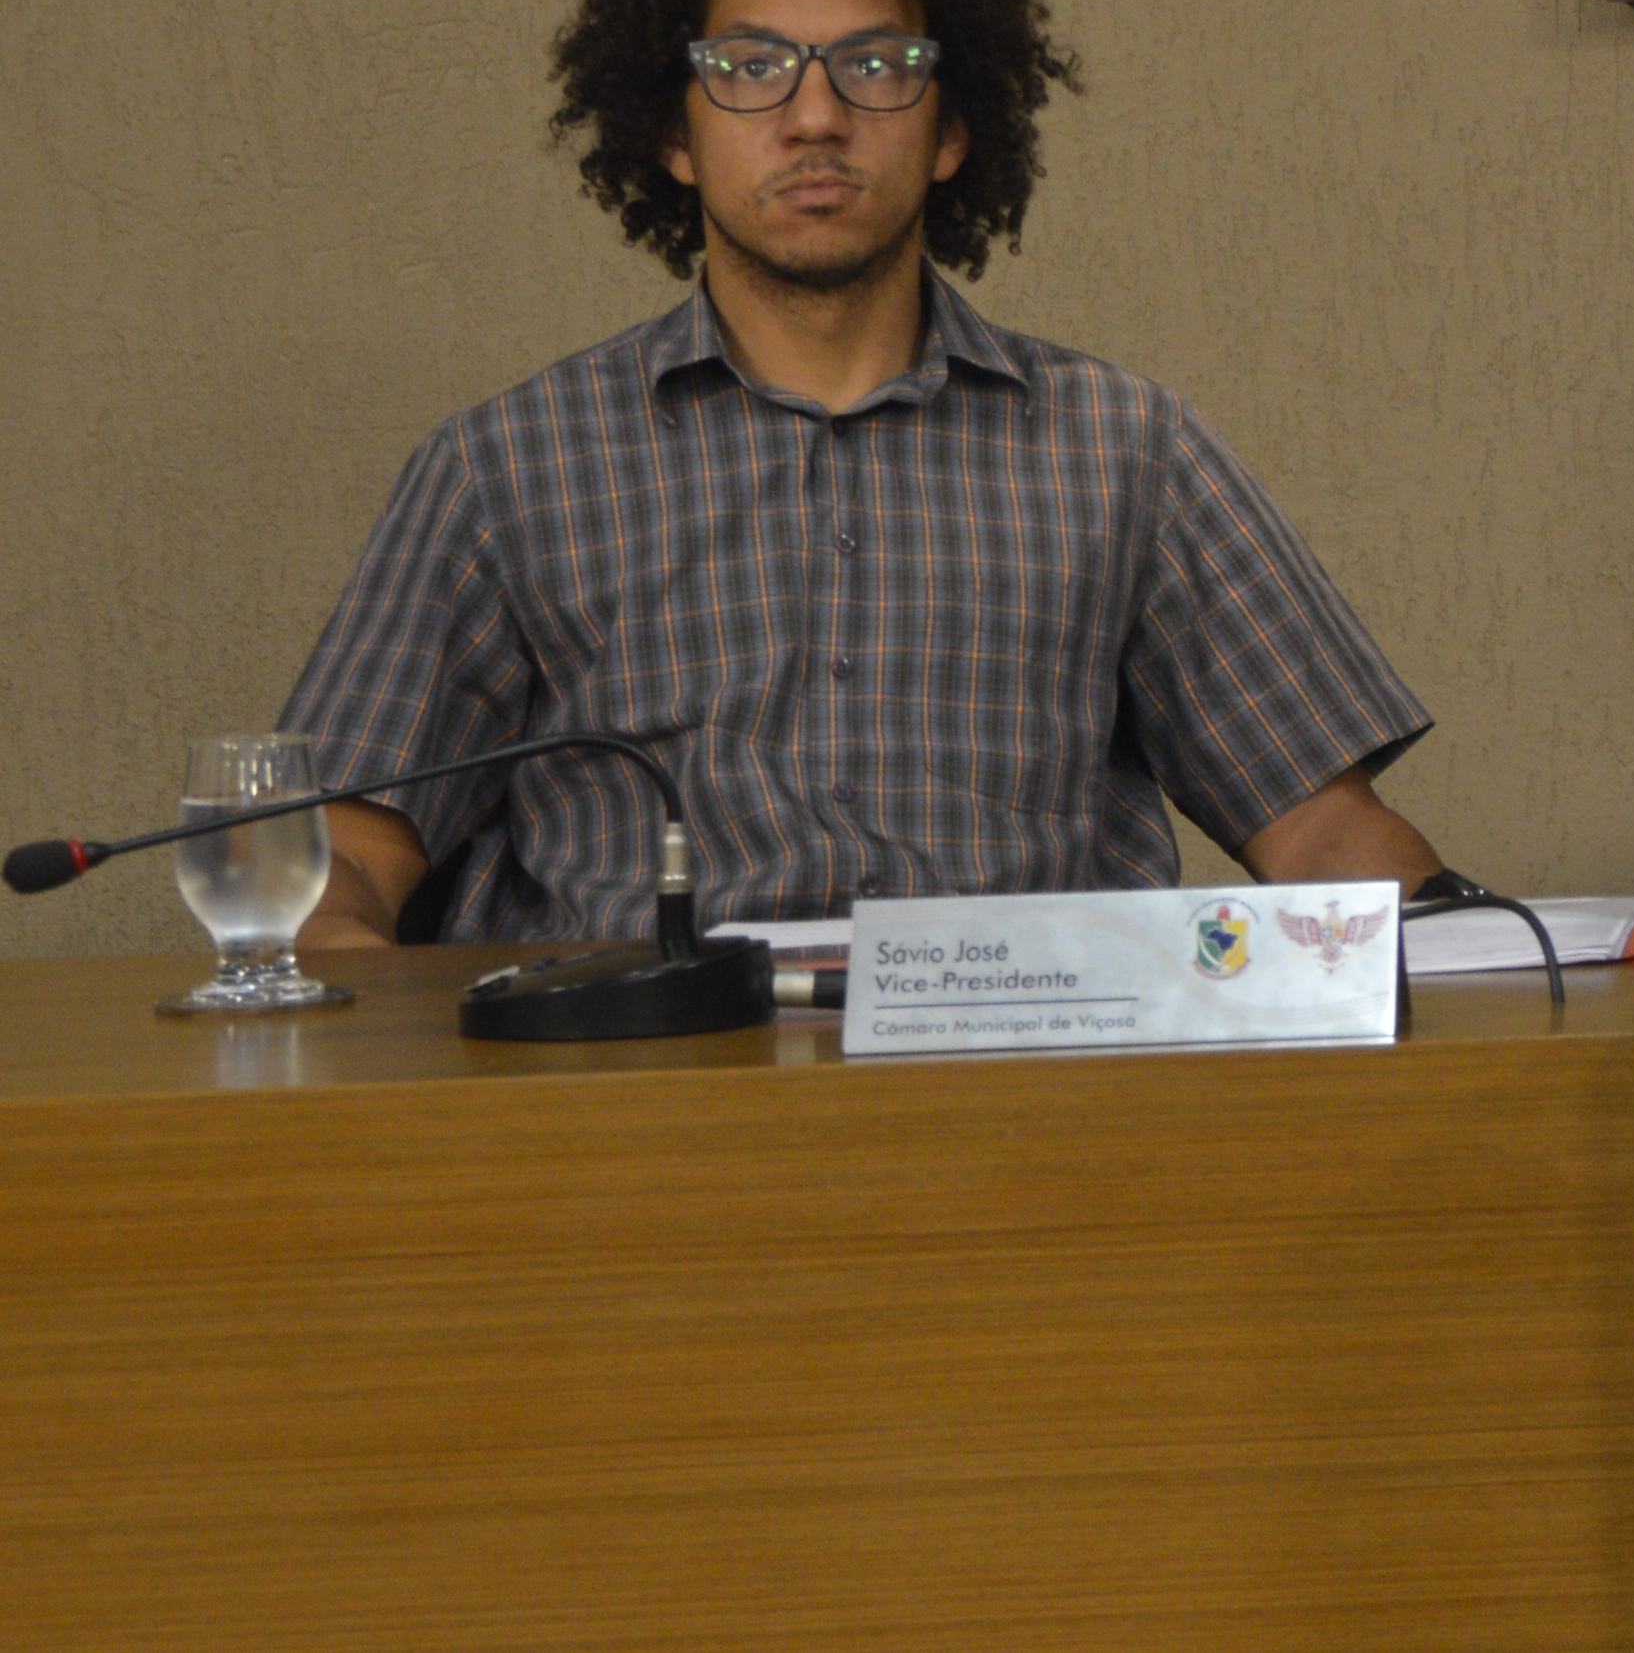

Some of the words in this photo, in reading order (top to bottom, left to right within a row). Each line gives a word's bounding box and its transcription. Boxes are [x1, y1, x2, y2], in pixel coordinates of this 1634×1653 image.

[877, 940, 944, 965] Sávio
[954, 939, 1009, 963] José
[875, 969, 1078, 993] Vice-Presidente
[873, 1020, 947, 1036] Câmara
[954, 1016, 1042, 1033] Municipal
[1049, 1015, 1070, 1030] de
[1078, 1014, 1135, 1031] Viçosa
